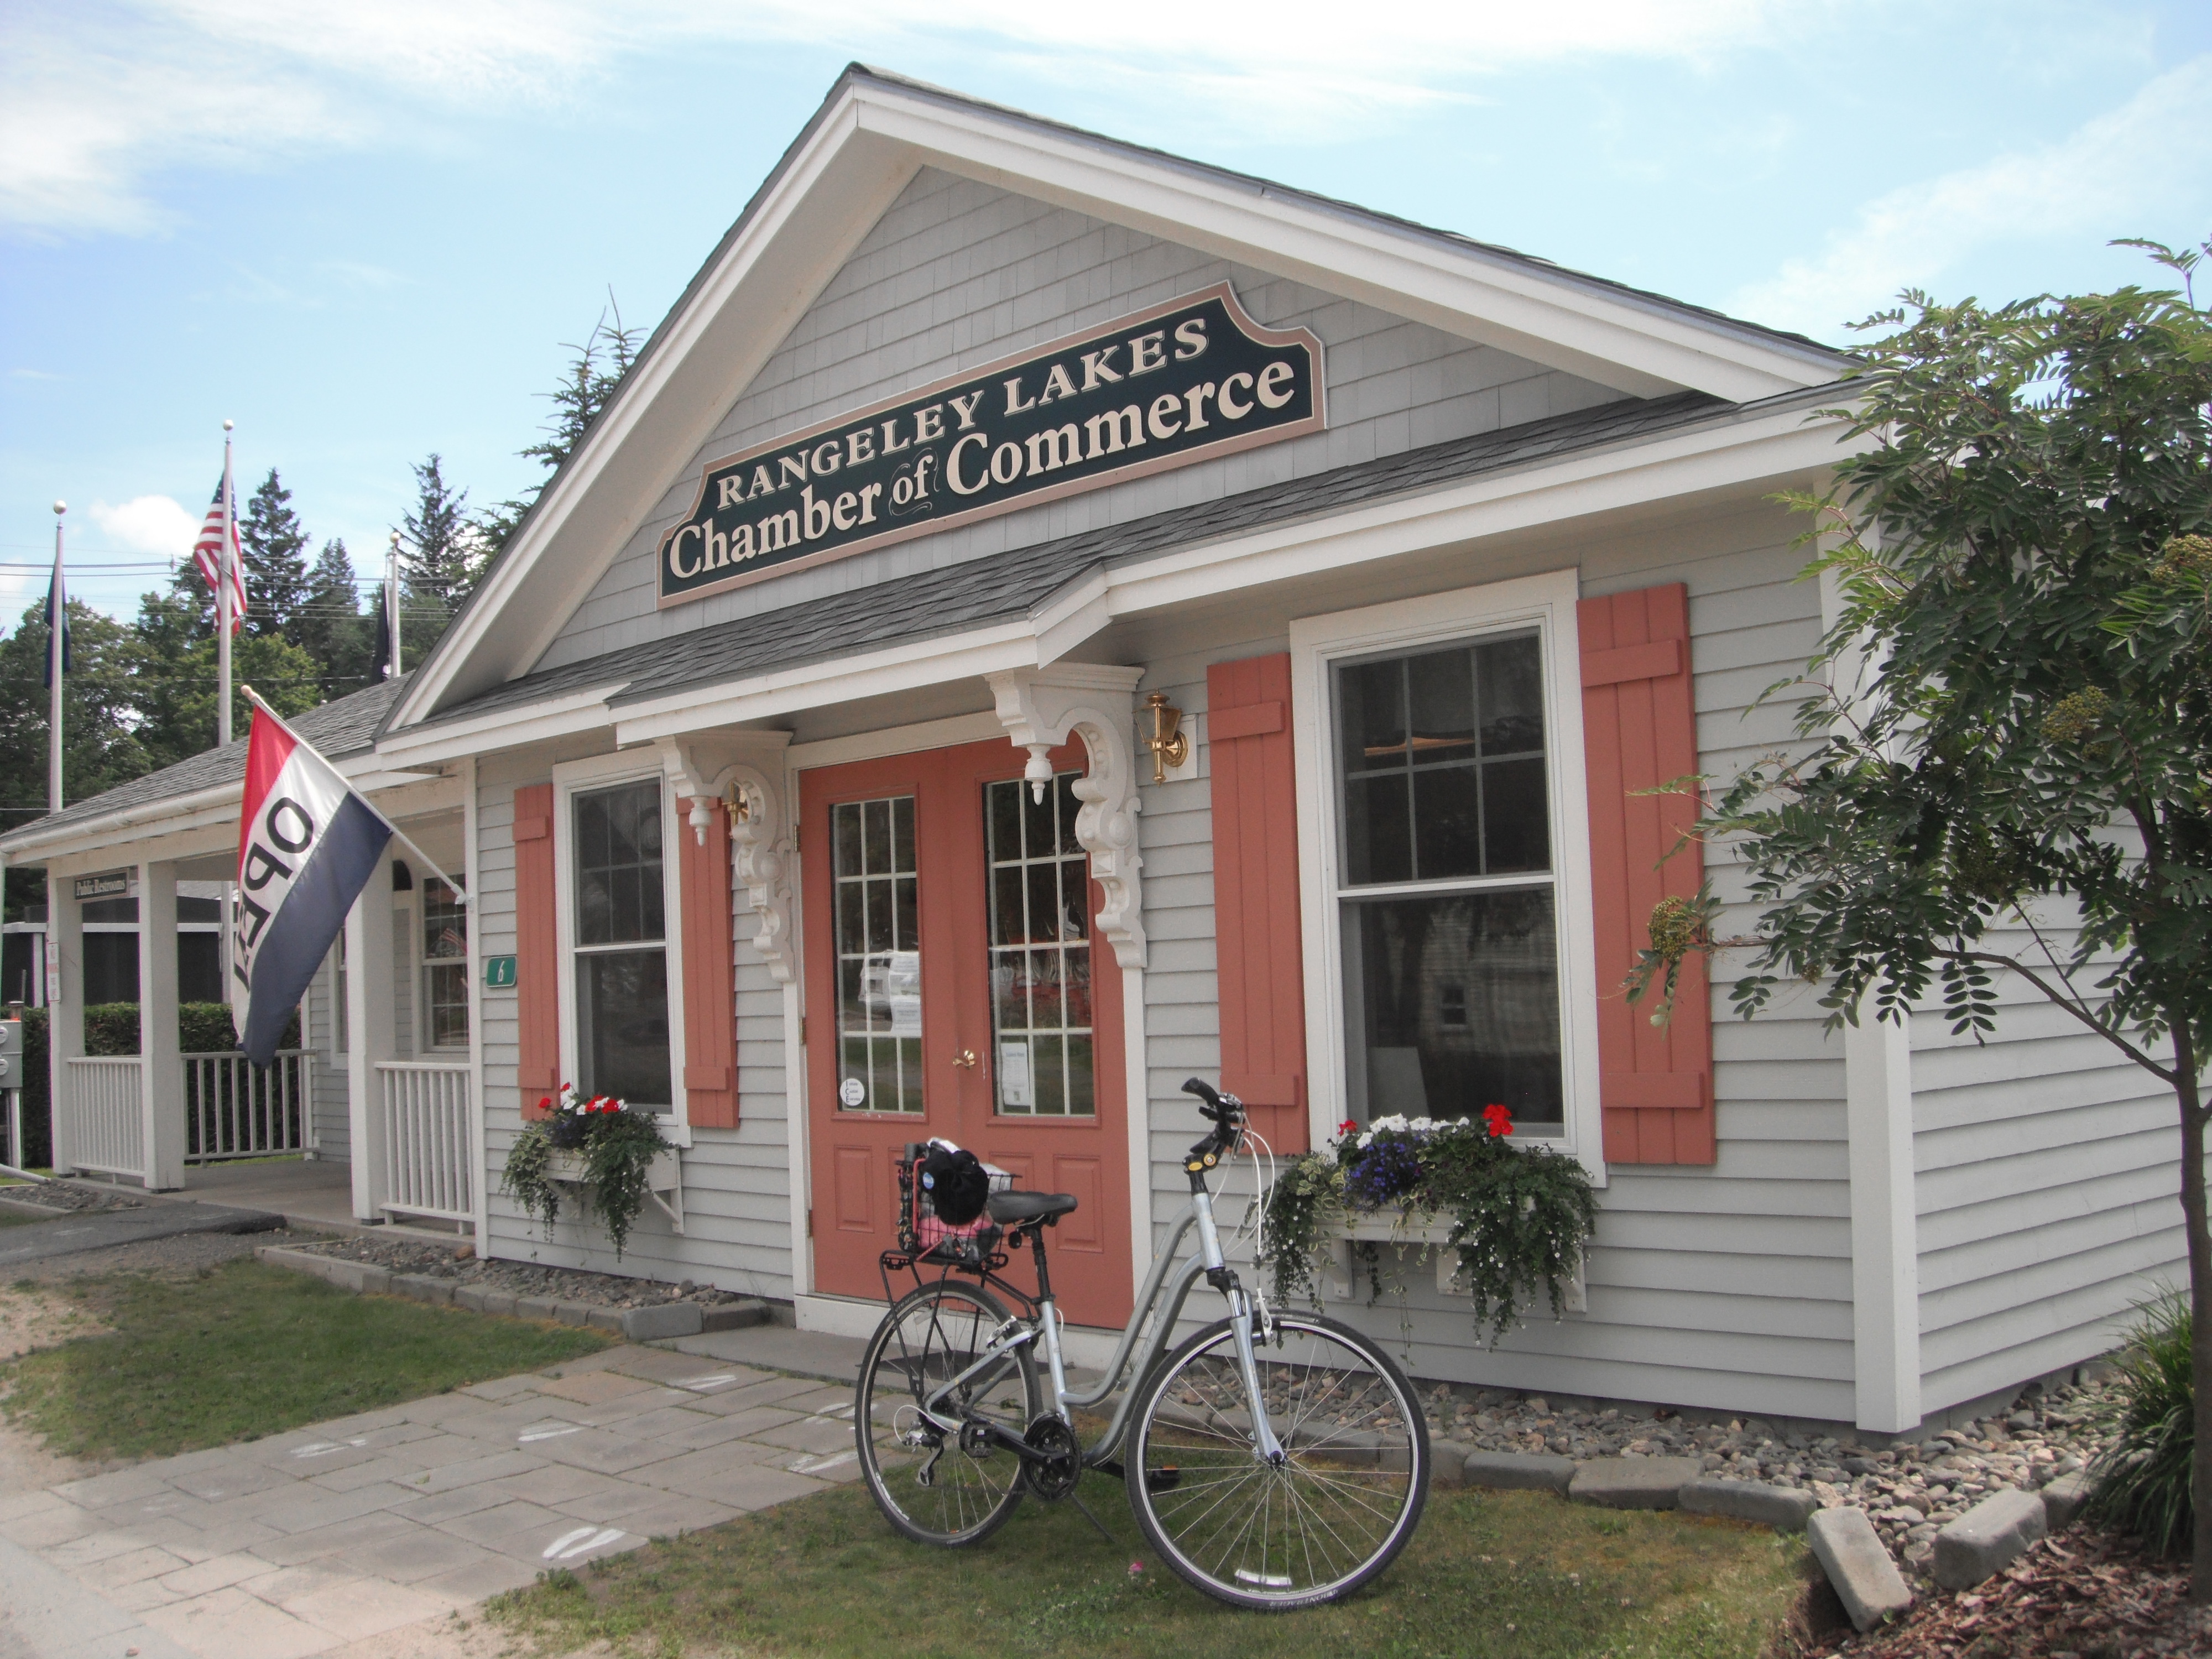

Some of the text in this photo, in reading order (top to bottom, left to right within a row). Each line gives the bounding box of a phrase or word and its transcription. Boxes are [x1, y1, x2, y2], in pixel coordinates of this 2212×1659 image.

[717, 318, 1209, 512] RANGELEY LAKES
[669, 361, 1295, 579] Chamber of Commerce
[76, 880, 93, 896] Public
[498, 961, 504, 982] 6
